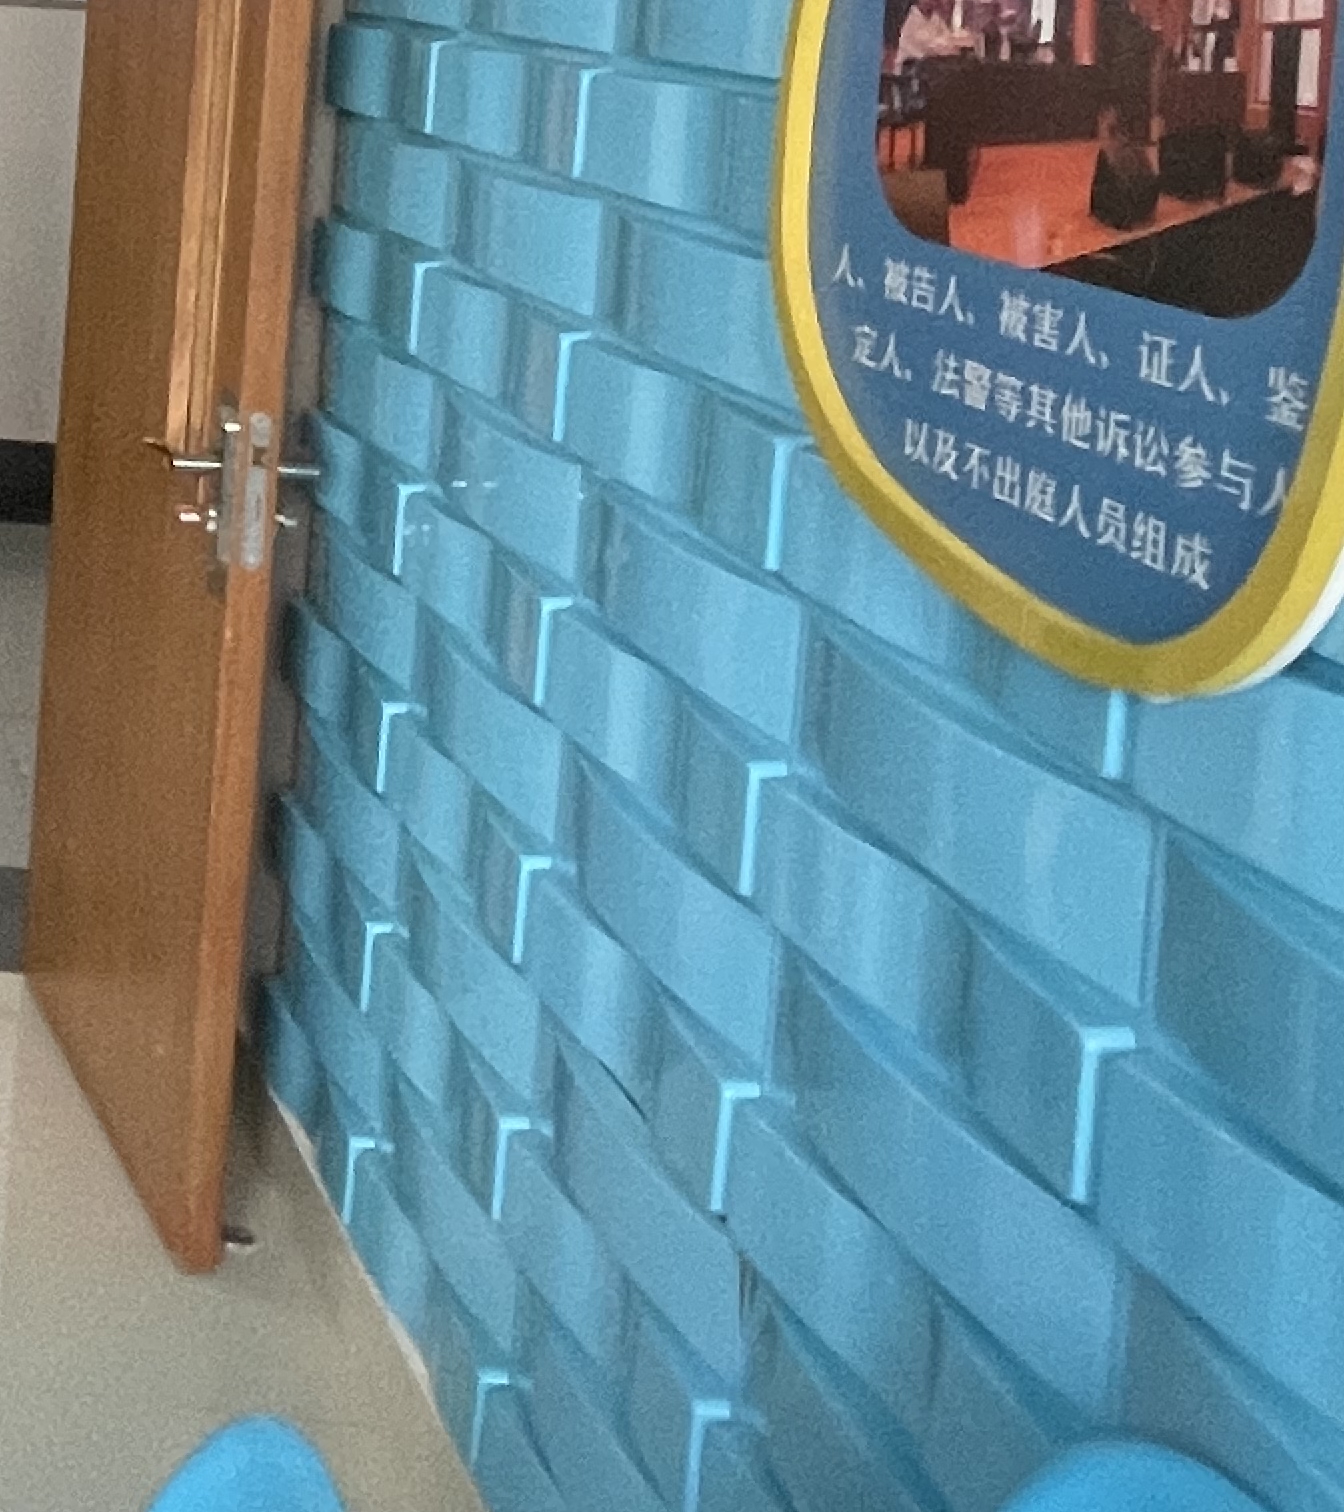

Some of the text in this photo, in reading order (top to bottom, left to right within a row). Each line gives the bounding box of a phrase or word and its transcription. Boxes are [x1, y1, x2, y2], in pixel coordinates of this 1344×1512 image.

[903, 417, 1214, 592] 以及不出庭人员组成
